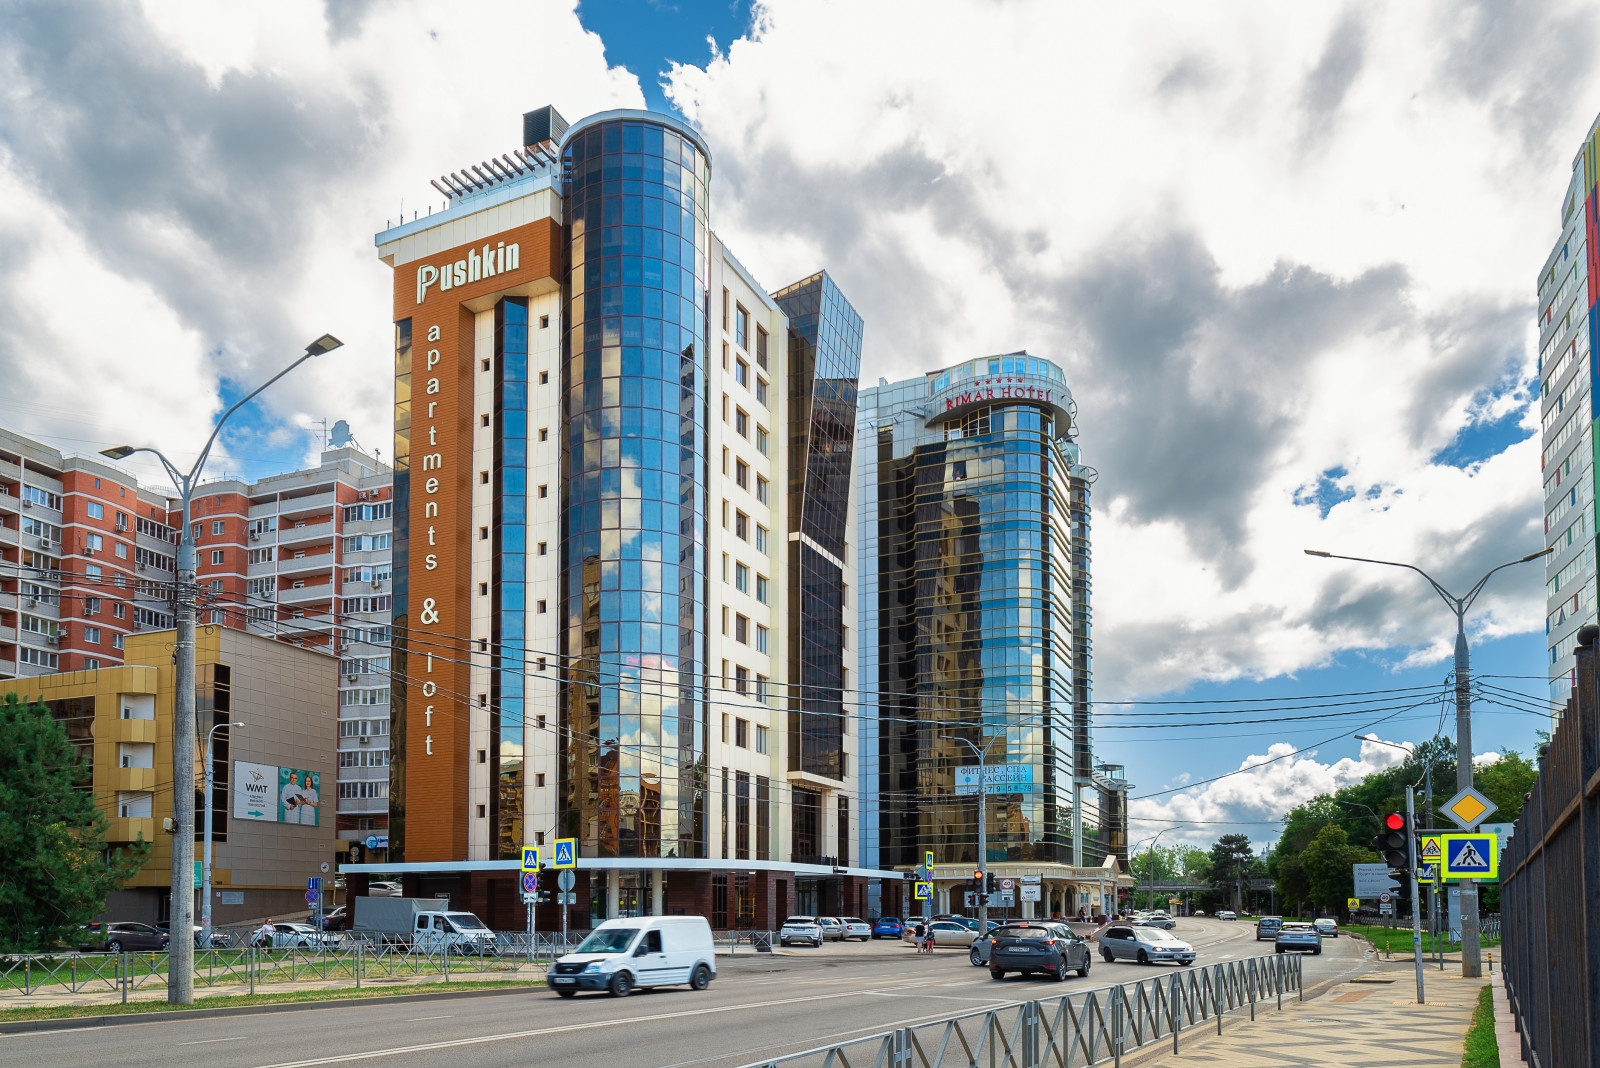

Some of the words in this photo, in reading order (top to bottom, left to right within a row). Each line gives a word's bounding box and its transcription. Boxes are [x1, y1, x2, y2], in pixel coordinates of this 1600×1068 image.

[416, 241, 520, 304] Pushkin
[946, 389, 995, 411] RIMAR
[1001, 387, 1053, 403] HOTEL
[422, 324, 441, 570] apartments
[420, 597, 439, 625] &
[422, 652, 437, 755] loft
[245, 783, 268, 793] WMT
